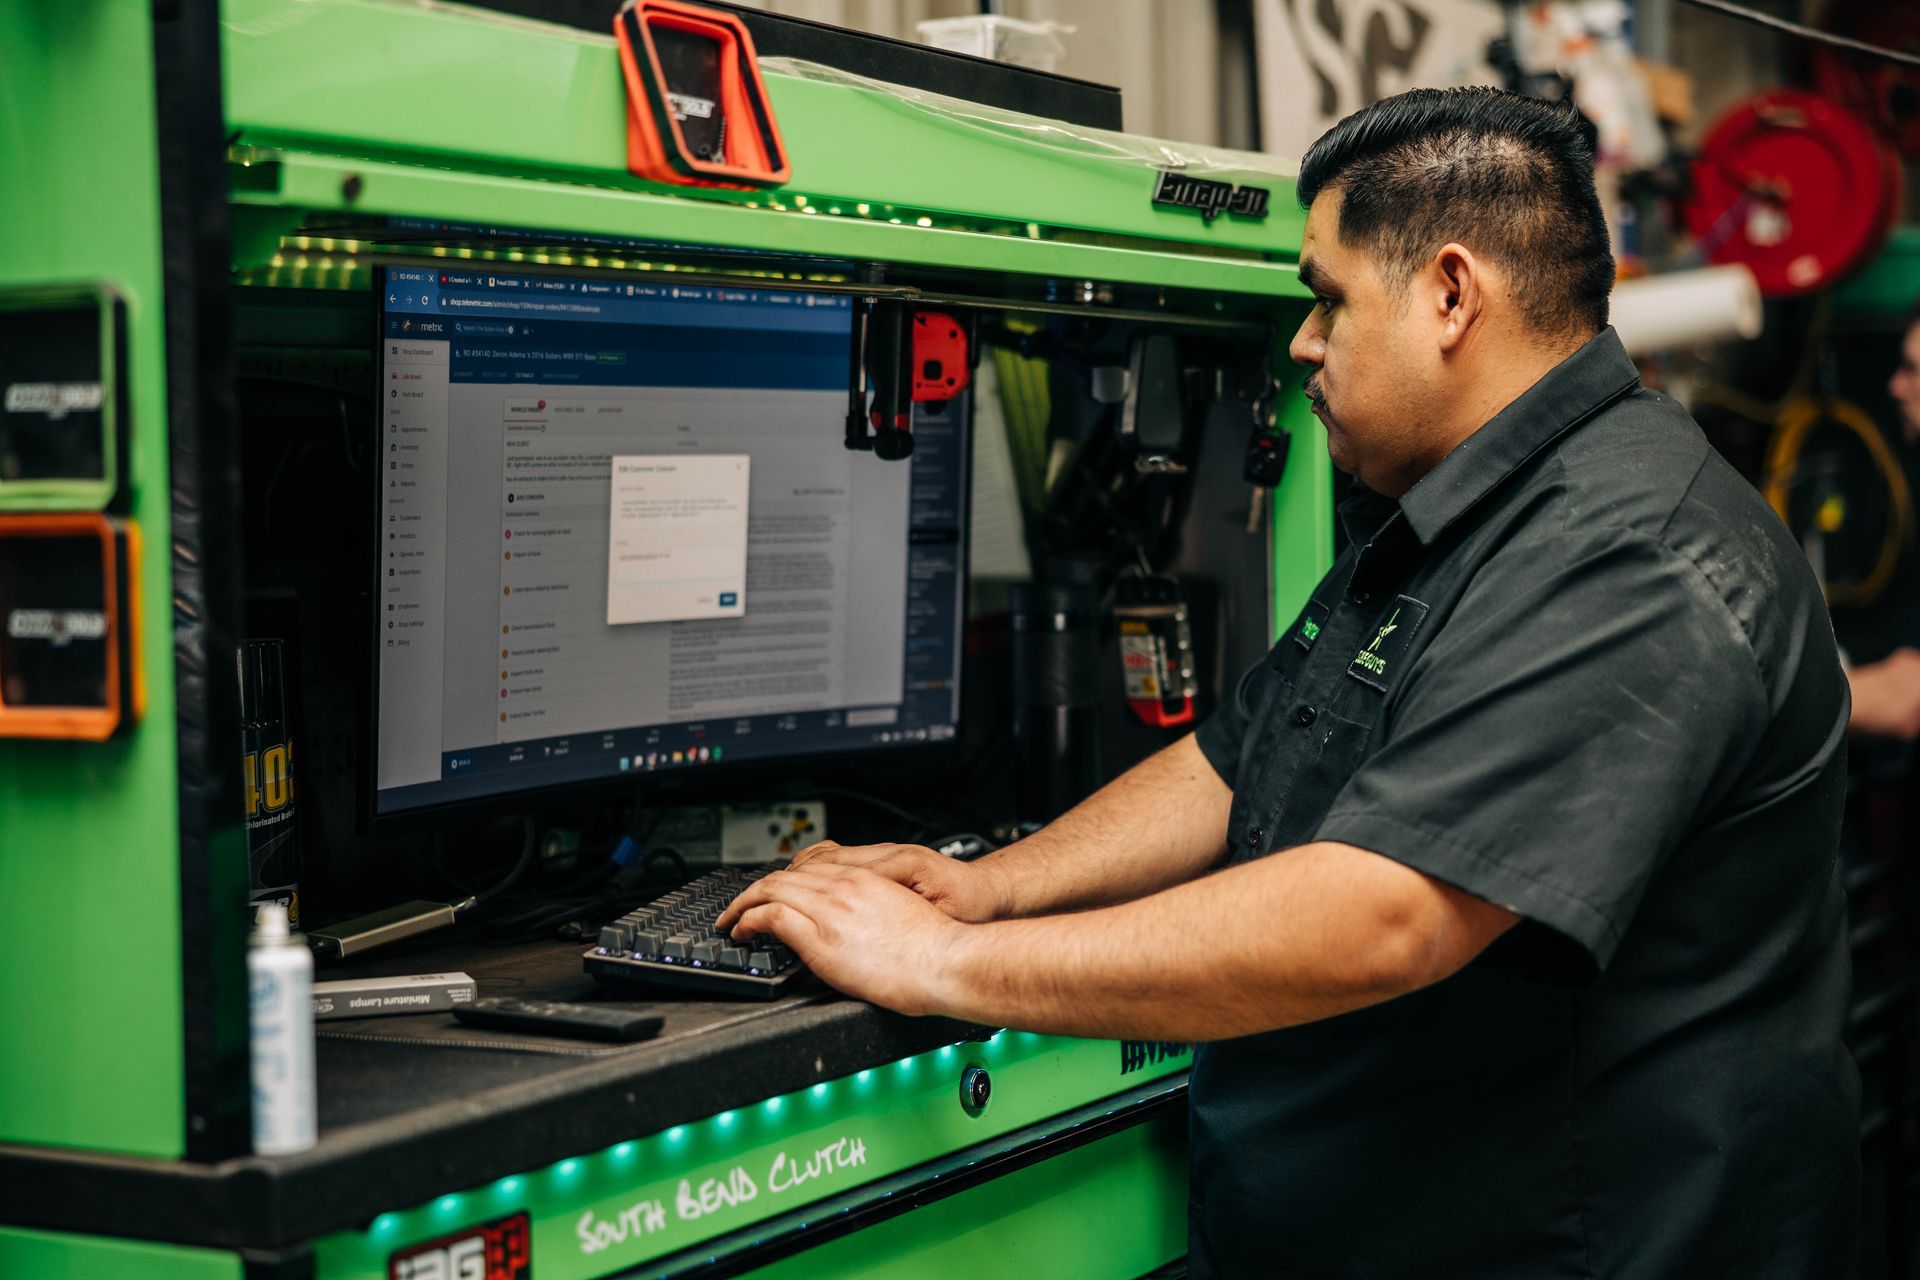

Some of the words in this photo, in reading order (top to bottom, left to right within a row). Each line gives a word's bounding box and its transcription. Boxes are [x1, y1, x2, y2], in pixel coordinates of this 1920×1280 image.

[350, 997, 382, 1008] Lamps
[383, 993, 431, 1006] Miniature
[576, 1199, 666, 1254] SOUTH
[676, 1166, 758, 1220] BEND
